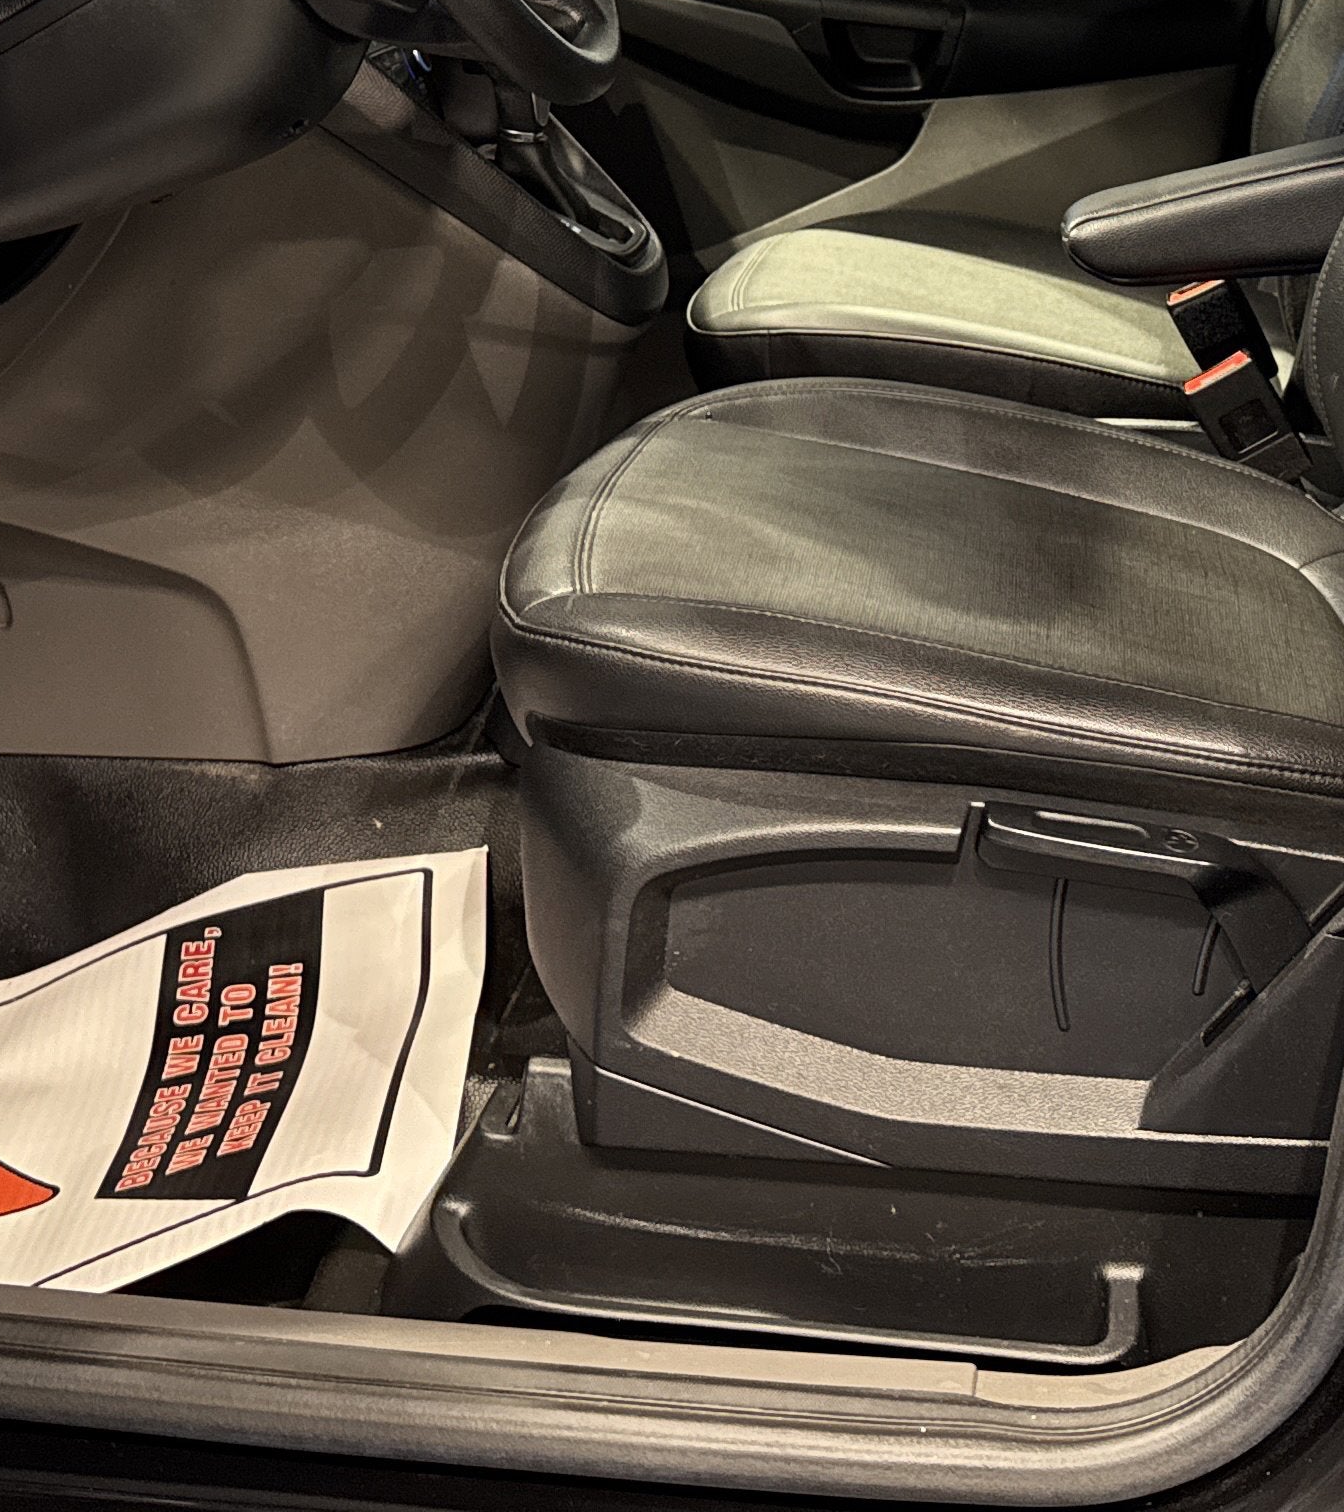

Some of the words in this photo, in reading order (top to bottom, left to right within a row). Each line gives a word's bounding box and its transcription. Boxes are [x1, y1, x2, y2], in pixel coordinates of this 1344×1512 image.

[173, 926, 222, 1026] CARE,
[218, 983, 256, 1027] TO
[255, 962, 303, 1067] CLEAN!
[162, 1034, 204, 1081] WE
[185, 1033, 249, 1136] WANTED
[244, 1070, 284, 1097] IT
[114, 1083, 192, 1193] BECAUSE
[165, 1134, 214, 1176] WE
[216, 1099, 271, 1157] KEEP
